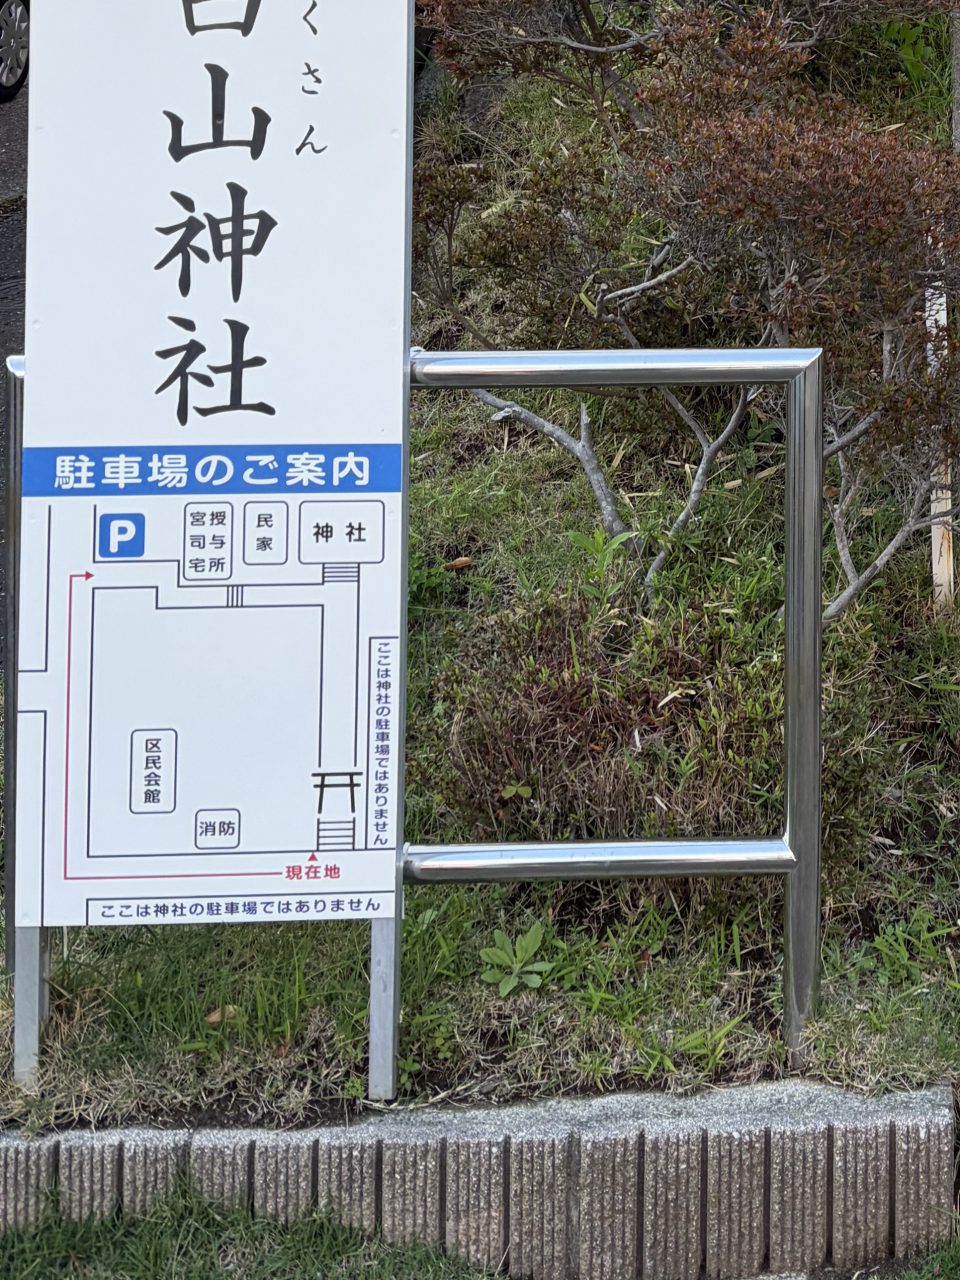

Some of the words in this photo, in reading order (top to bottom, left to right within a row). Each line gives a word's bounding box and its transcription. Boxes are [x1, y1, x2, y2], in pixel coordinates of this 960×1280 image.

[53, 451, 370, 490] 駐車場のご案内
[109, 519, 137, 554] P
[188, 511, 207, 573] 宮司宅
[208, 510, 227, 573] 授与所
[255, 513, 274, 552] 民家
[312, 521, 367, 544] 神社
[373, 642, 391, 845] ここは神社の駐車場ではありません
[143, 738, 162, 804] 区民会館
[199, 820, 236, 837] 消防
[284, 863, 341, 881] 現在地
[101, 897, 380, 918] ここは神社の駐車場ではありません
